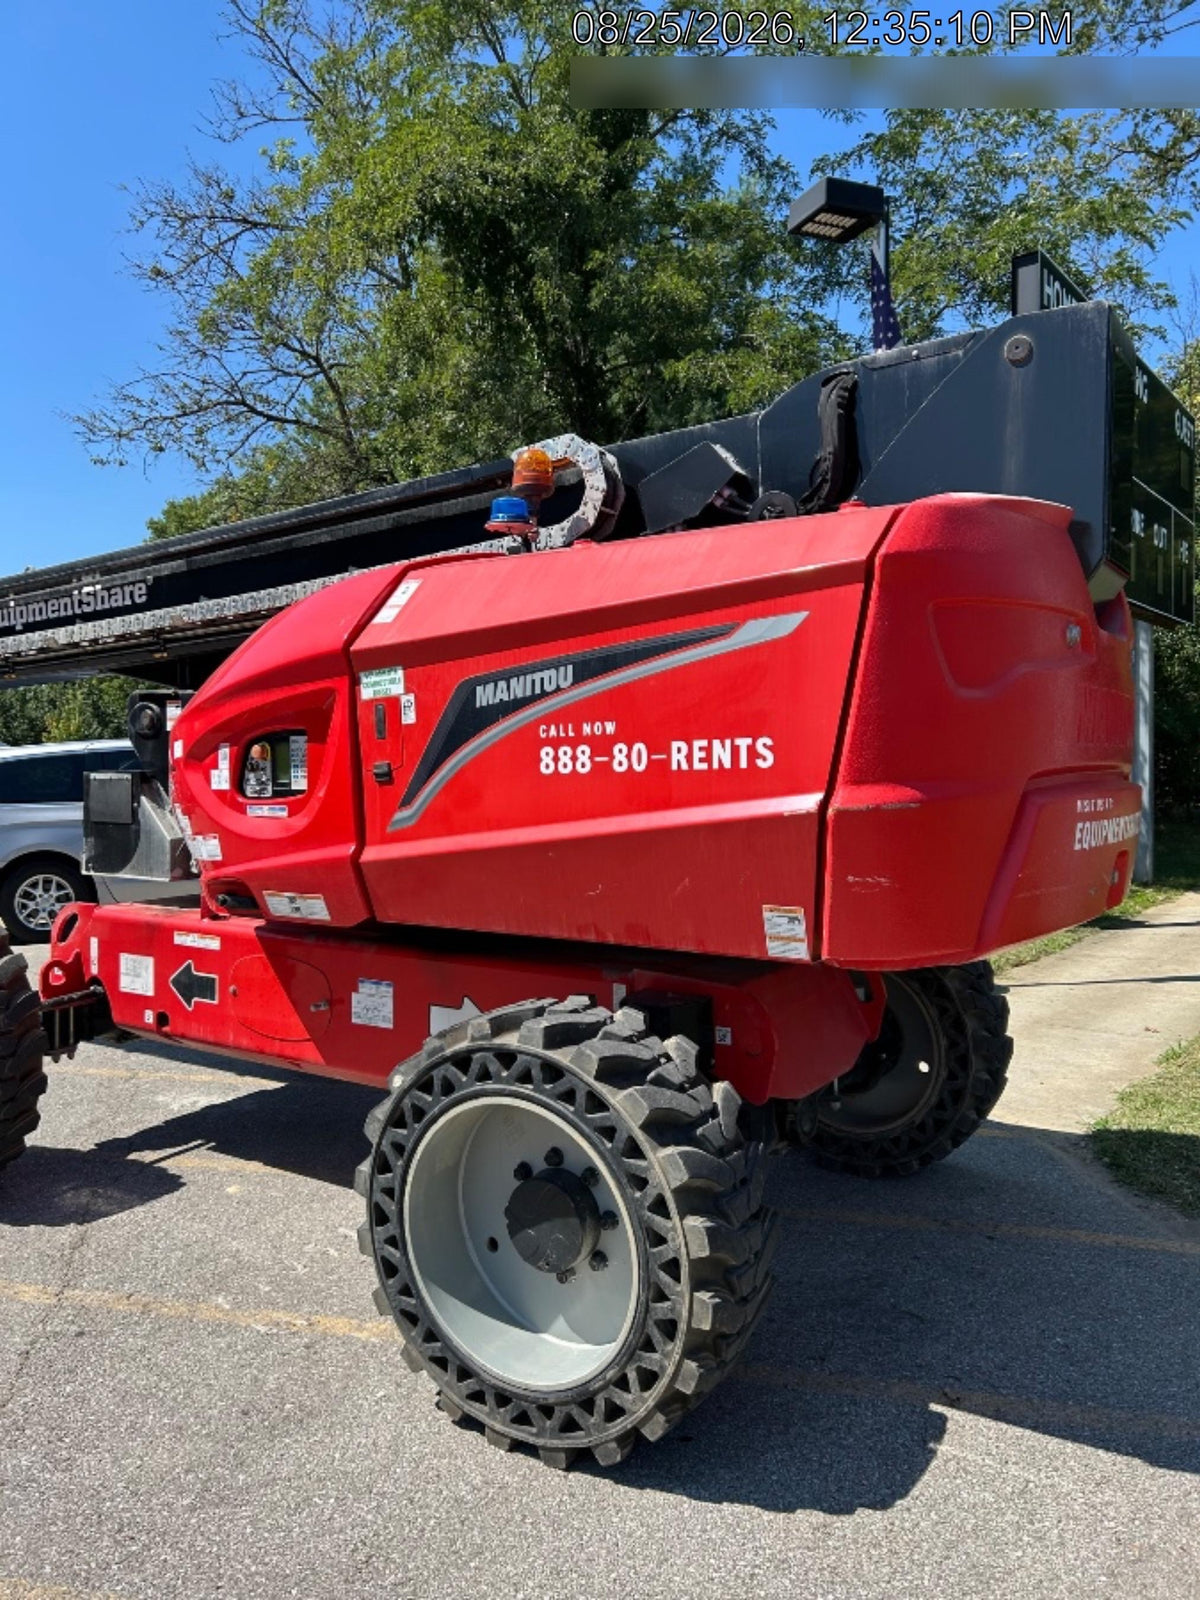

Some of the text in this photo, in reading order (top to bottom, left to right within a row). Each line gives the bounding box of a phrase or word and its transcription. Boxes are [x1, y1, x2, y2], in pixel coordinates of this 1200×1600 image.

[1043, 268, 1077, 309] HOM
[475, 664, 574, 708] MANITOU
[540, 721, 616, 738] CALL NOW
[539, 736, 774, 775] 888-80-RENTS
